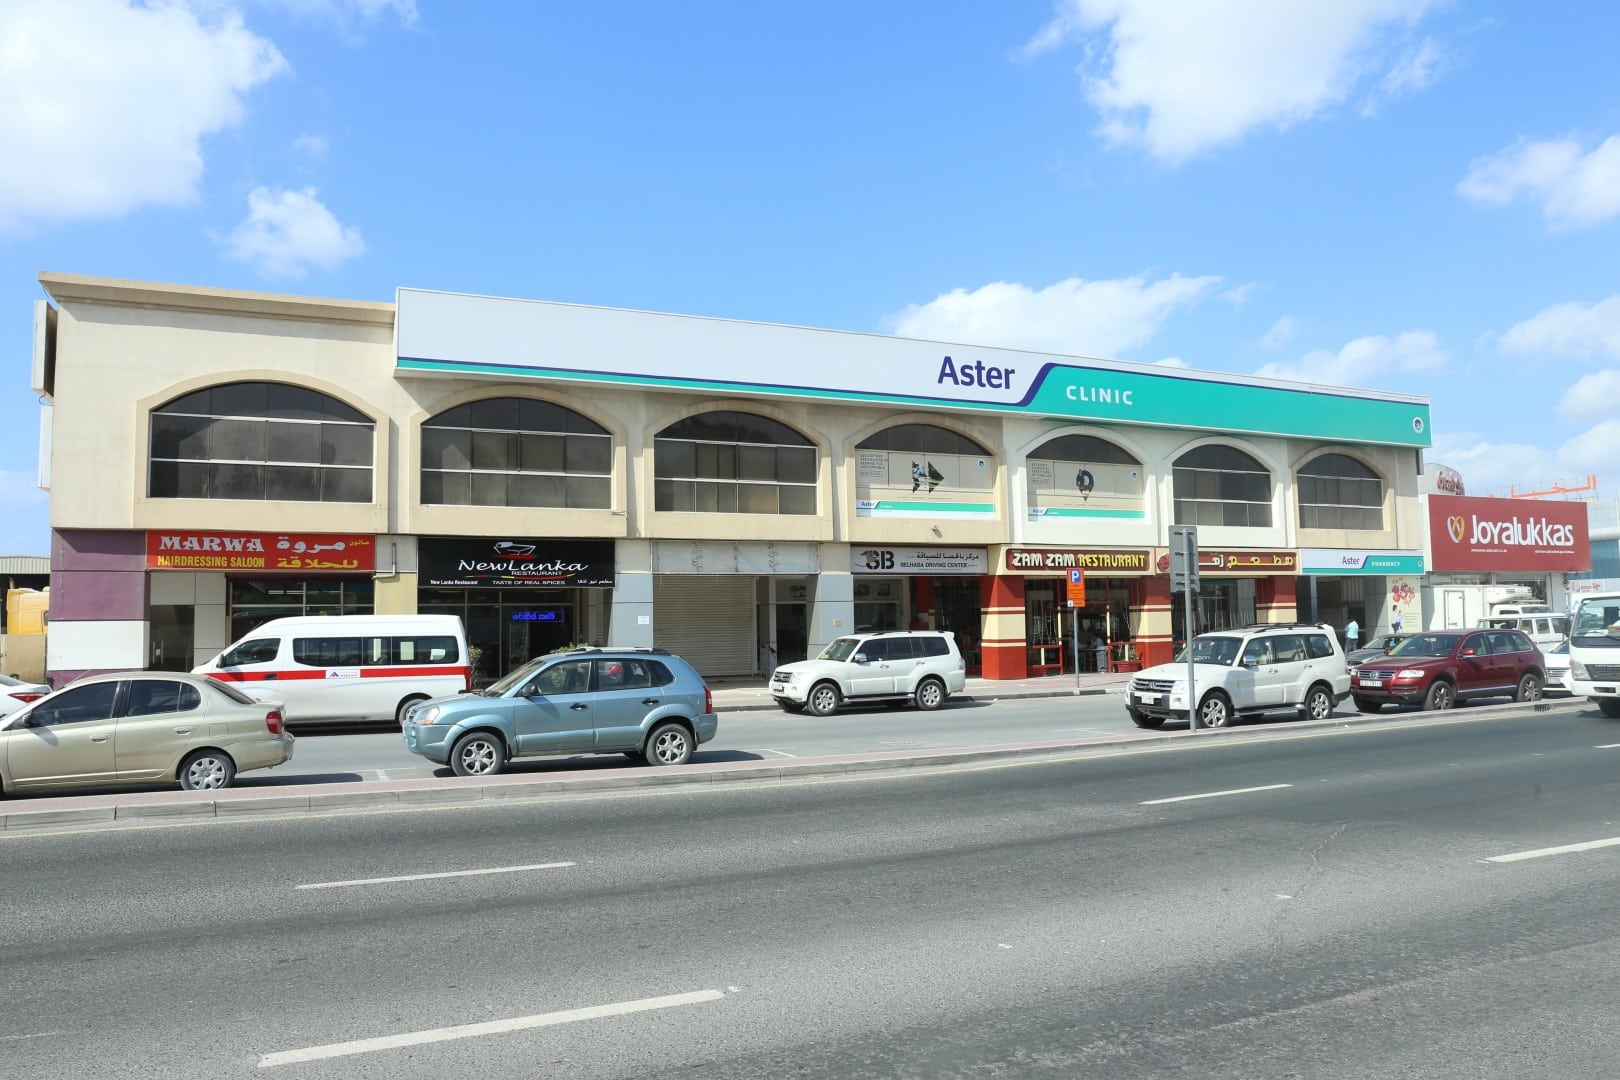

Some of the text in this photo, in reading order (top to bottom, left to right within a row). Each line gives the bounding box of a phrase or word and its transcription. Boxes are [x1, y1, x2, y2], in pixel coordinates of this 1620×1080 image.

[938, 356, 1015, 389] Aster
[1066, 385, 1133, 405] CLINIC
[1470, 514, 1574, 547] Joyalukkas
[159, 536, 265, 552] MARWA
[276, 536, 370, 554] صالون مروة
[158, 555, 265, 568] HAIRDRESSING SALOON
[276, 556, 359, 569] للحلاقة
[1012, 550, 1145, 568] ZAM ZAM RESTAURANT
[1227, 555, 1294, 568] مطعم
[1342, 556, 1360, 566] Aster
[1071, 570, 1080, 583] P
